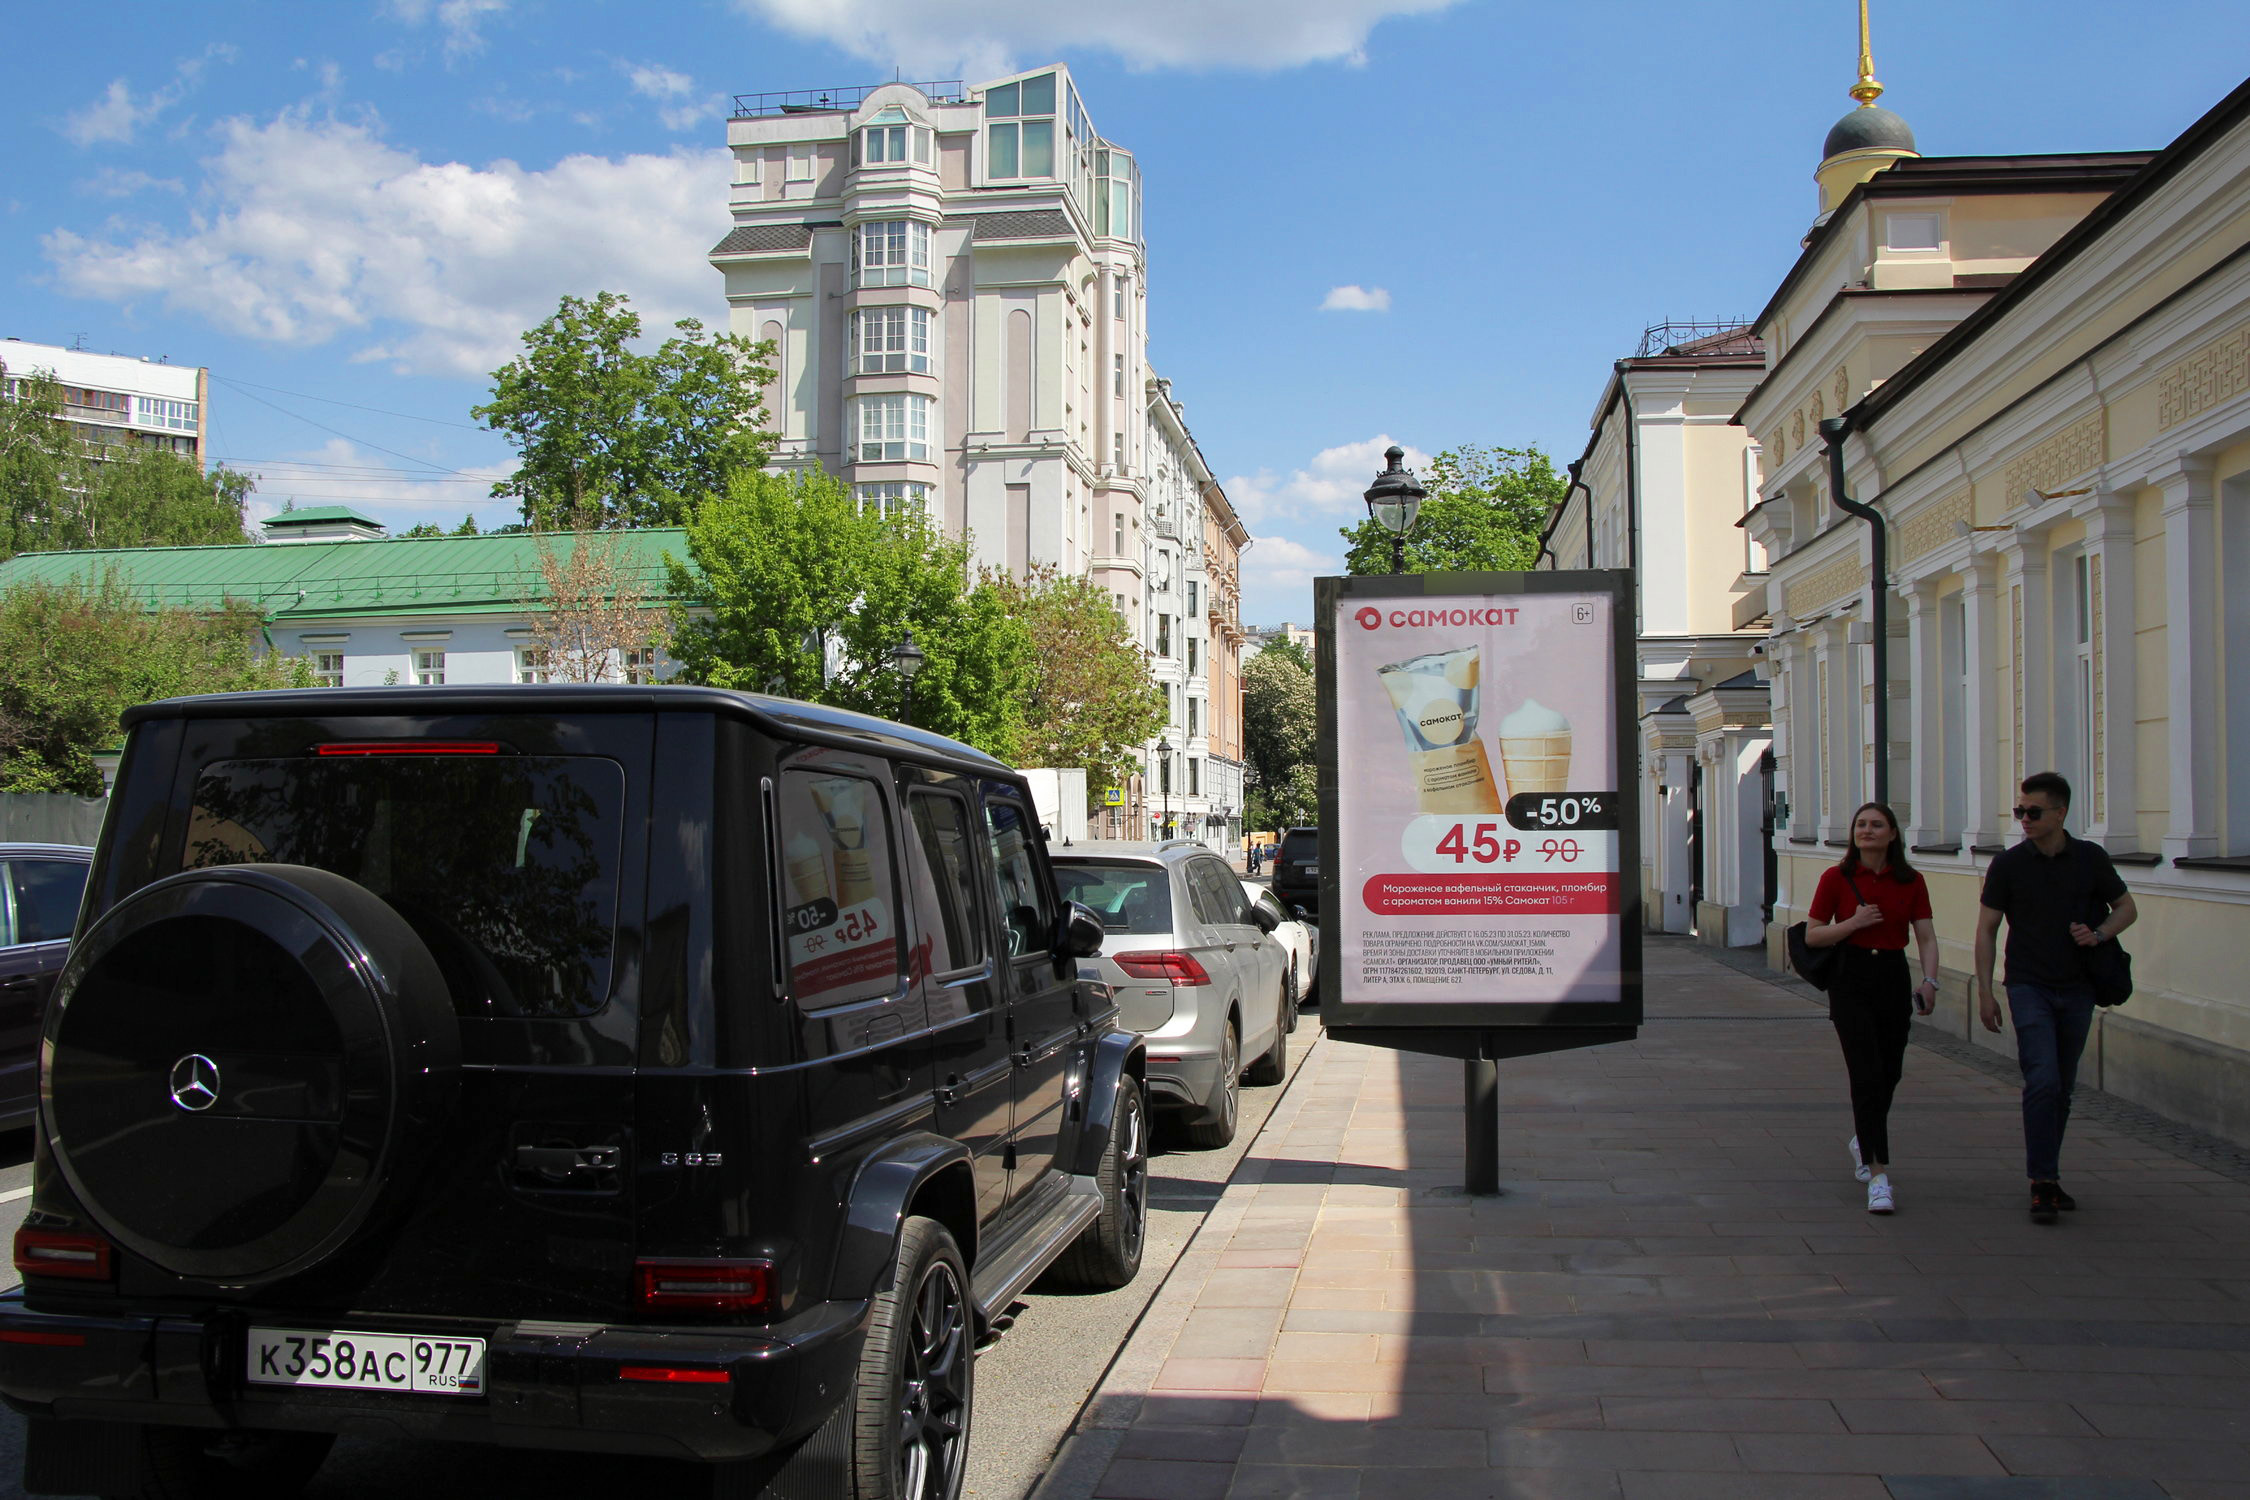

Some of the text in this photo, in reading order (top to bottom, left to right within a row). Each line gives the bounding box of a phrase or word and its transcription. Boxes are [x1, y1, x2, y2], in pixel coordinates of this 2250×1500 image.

[1389, 607, 1520, 628] самокат
[1577, 607, 1590, 620] 6+
[1420, 713, 1462, 727] самокат
[1526, 798, 1602, 825] -50%
[1383, 883, 1607, 894] Мороженое вафельный стаканчик, пломбир
[1391, 898, 1442, 907] ароматом
[1484, 896, 1503, 905] 15%
[1505, 896, 1550, 905] Самокат
[1552, 896, 1568, 904] 105
[1392, 931, 1434, 939] ПРЕДЛОЖЕНИЕ
[1435, 931, 1467, 939] ДЕЙСТВУЕТ
[1498, 931, 1506, 939] ПО
[1533, 931, 1570, 939] КОЛИЧЕСТВО
[1362, 967, 1378, 975] ОГРН
[1363, 976, 1381, 984] ЛИТЕР
[1389, 976, 1405, 984] ЭТАЖ
[1412, 976, 1450, 984] ПОМЕЩЕНИЕ
[415, 1341, 472, 1375] 977
[429, 1374, 458, 1387] RUS
